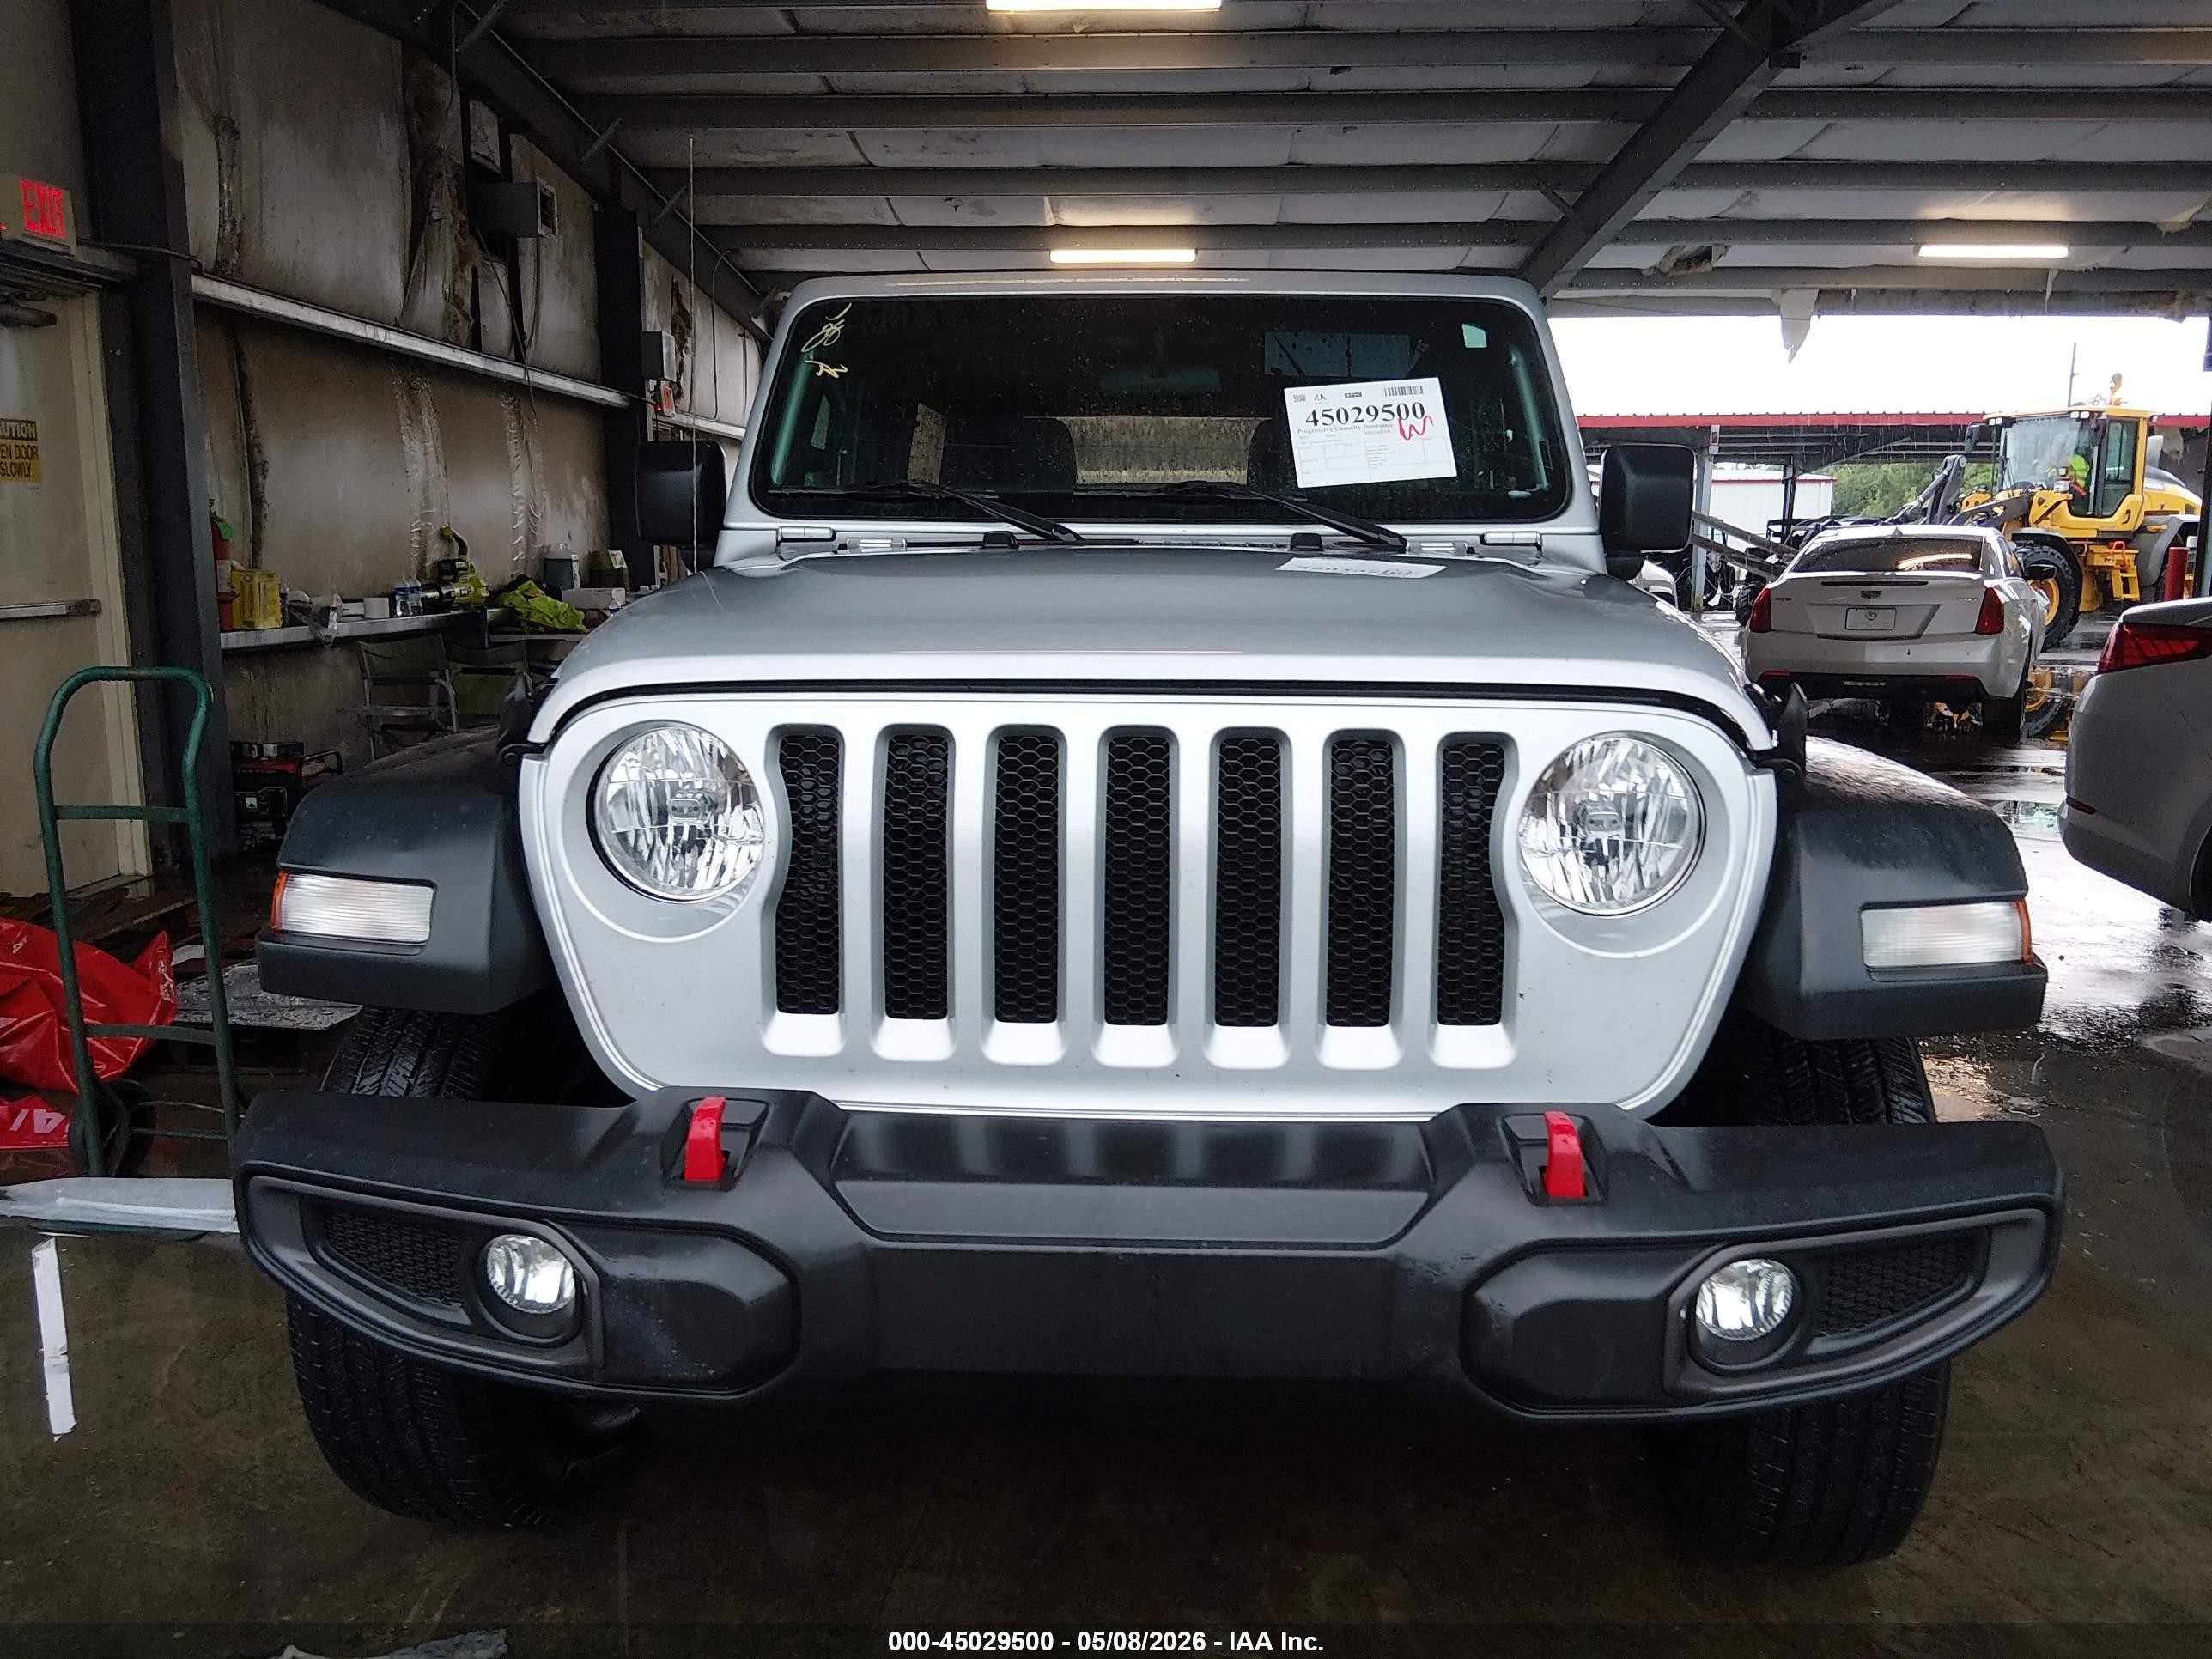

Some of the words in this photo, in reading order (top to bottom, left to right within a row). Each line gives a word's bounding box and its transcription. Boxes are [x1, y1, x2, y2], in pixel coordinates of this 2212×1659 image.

[21, 178, 65, 240] EXIT
[1305, 401, 1425, 427] 45029500
[1297, 426, 1334, 434] Progressive
[0, 444, 12, 460] EN
[15, 445, 39, 461] DOOR
[0, 461, 32, 477] SLOWLY
